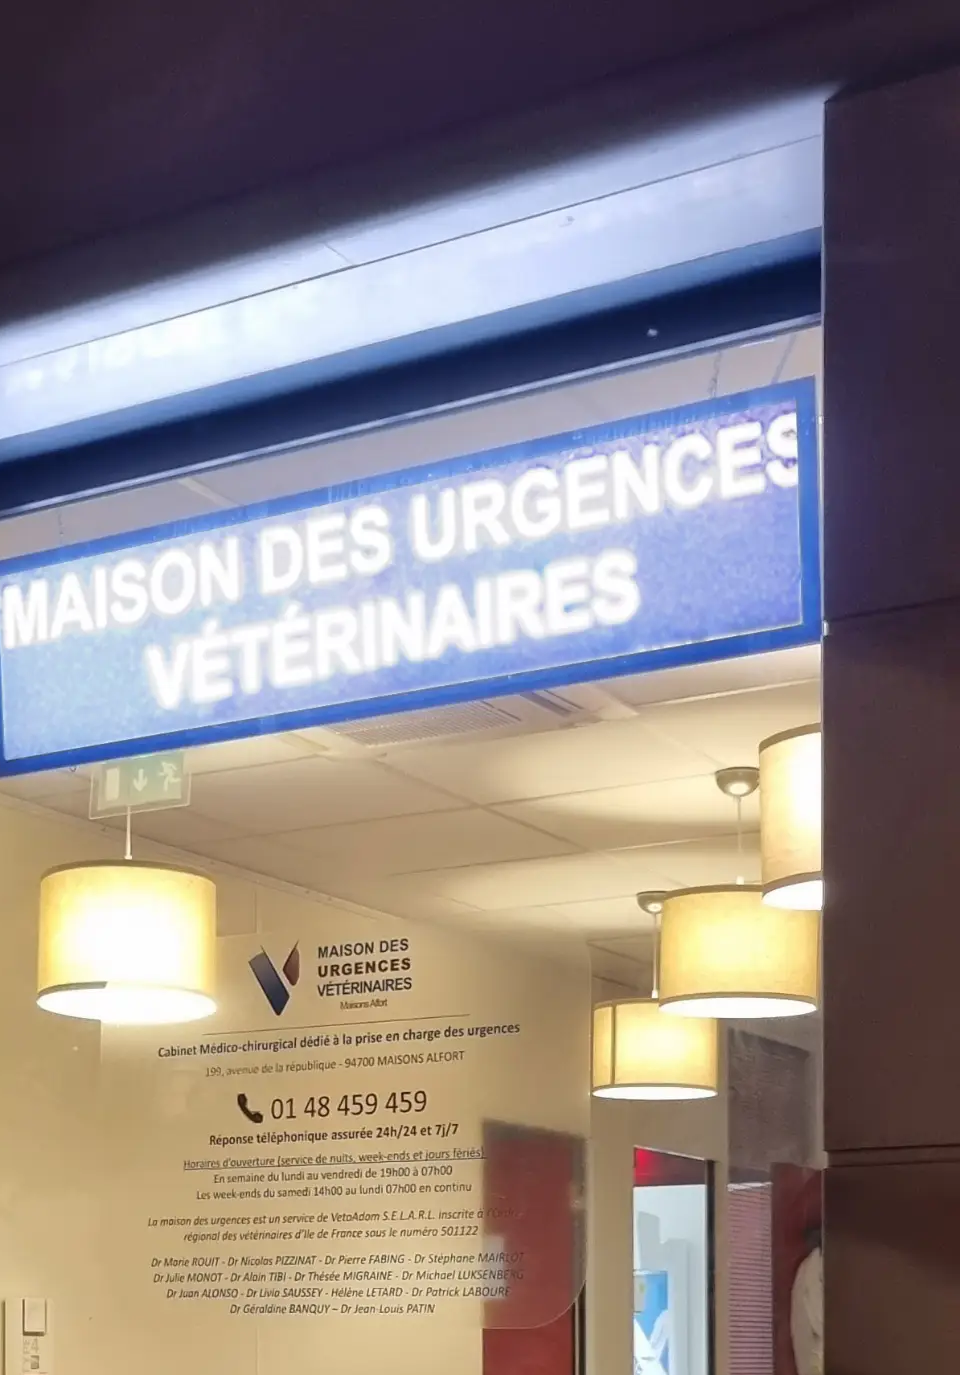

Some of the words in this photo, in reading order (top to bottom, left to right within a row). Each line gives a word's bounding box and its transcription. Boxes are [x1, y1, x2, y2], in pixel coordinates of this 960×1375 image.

[0, 543, 239, 650] MAISON
[259, 505, 392, 597] DES
[410, 409, 799, 558] URGENCES
[143, 548, 640, 710] VÉTÉRINAIRES
[317, 941, 375, 959] MAISON
[379, 938, 409, 953] DES
[317, 957, 412, 978] URGENCES
[317, 977, 412, 997] VÉTÉRINAIRES
[340, 1000, 368, 1010] Maisons
[158, 1045, 197, 1058] Cabinet
[200, 1038, 297, 1055] Médico-chirurgical
[300, 1035, 330, 1048] dédié
[333, 1035, 340, 1046] à
[342, 1033, 352, 1045] la
[355, 1031, 382, 1047] prise
[385, 1031, 400, 1042] en
[403, 1028, 441, 1044] charge
[444, 1026, 464, 1038] des
[467, 1023, 520, 1037] urgences
[205, 1066, 224, 1077] 199,
[226, 1066, 259, 1076] avenue
[261, 1063, 273, 1074] de
[275, 1062, 283, 1073] la
[286, 1058, 337, 1073] république
[344, 1056, 375, 1068] 94700
[377, 1053, 424, 1066] MAISONS
[427, 1050, 465, 1063] ALFORT
[271, 1097, 296, 1120] 01
[304, 1095, 330, 1118] 48
[337, 1093, 378, 1116] 459
[385, 1090, 427, 1113] 459
[209, 1135, 254, 1148] Réponse
[256, 1131, 328, 1145] téléphonique
[331, 1127, 373, 1141] assurée
[375, 1124, 417, 1140] 24h/24
[420, 1126, 432, 1137] et
[435, 1122, 459, 1138] 7j/7
[183, 1158, 220, 1169] Horaires
[222, 1157, 275, 1167] d'ouverture
[277, 1155, 313, 1167] (service
[315, 1153, 327, 1164] de
[330, 1153, 355, 1164] nuits,
[359, 1150, 411, 1161] week-ends
[413, 1150, 423, 1160] et
[425, 1149, 450, 1161] jours
[453, 1146, 485, 1159] fériés)
[214, 1174, 225, 1184] En
[227, 1172, 265, 1183] semaine
[268, 1171, 279, 1182] du
[282, 1170, 305, 1181] lundi
[306, 1172, 319, 1181] au
[321, 1168, 362, 1180] vendredi
[365, 1168, 377, 1179] de
[380, 1166, 411, 1178] 19h00
[412, 1167, 420, 1177] à
[421, 1165, 453, 1176] 07h00
[196, 1190, 211, 1201] Les
[213, 1188, 261, 1200] week-ends
[263, 1187, 275, 1198] du
[277, 1186, 311, 1198] samedi
[314, 1185, 343, 1197] 14h00
[345, 1187, 357, 1196] au
[359, 1184, 383, 1195] lundi
[386, 1183, 416, 1194] 07h00
[419, 1185, 431, 1194] en
[434, 1182, 472, 1193] continu
[147, 1217, 158, 1227] La
[160, 1217, 191, 1227] maison
[193, 1216, 208, 1226] des
[211, 1216, 251, 1227] urgences
[253, 1215, 267, 1225] est
[268, 1215, 280, 1224] un
[282, 1213, 315, 1224] service
[317, 1213, 329, 1223] de
[477, 1207, 485, 1218] à
[184, 1231, 220, 1244] régional
[222, 1230, 237, 1241] des
[239, 1229, 293, 1241] vétérinaires
[317, 1229, 329, 1239] de
[331, 1227, 363, 1239] France
[365, 1228, 386, 1238] sous
[388, 1227, 398, 1237] le
[400, 1226, 438, 1237] numéro
[441, 1225, 478, 1236] 501122
[151, 1257, 162, 1267] Dr
[163, 1258, 189, 1267] Marie
[191, 1257, 220, 1267] ROUIT
[227, 1257, 239, 1267] Dr
[241, 1256, 273, 1266] Nicolas
[275, 1255, 317, 1266] PIZZINAT
[325, 1255, 336, 1265] Dr
[338, 1254, 366, 1265] Pierre
[368, 1254, 405, 1265] FABING
[414, 1254, 426, 1264] Dr
[428, 1252, 475, 1265] Stéphane
[153, 1273, 164, 1283] Dr
[165, 1273, 185, 1283] Julie
[187, 1272, 223, 1283] MONOT
[230, 1272, 241, 1282] Dr
[243, 1272, 266, 1282] Alain
[268, 1272, 286, 1282] TIBI
[294, 1271, 305, 1281] Dr
[308, 1270, 340, 1281] Thésée
[343, 1271, 392, 1282] MIGRAINE
[402, 1271, 413, 1281] Dr
[167, 1288, 177, 1298] Dr
[179, 1288, 199, 1299] Juan
[201, 1288, 239, 1299] ALONSO
[246, 1288, 257, 1298] Dr
[259, 1287, 280, 1298] Livia
[281, 1287, 323, 1298] SAUSSEY
[331, 1287, 363, 1297] Hélène
[366, 1286, 403, 1297] LETARD
[412, 1287, 423, 1297] Dr
[425, 1286, 459, 1297] Patrick
[230, 1304, 240, 1314] Dr
[243, 1303, 287, 1314] Géraldine
[289, 1304, 330, 1315] BANQUY
[340, 1303, 352, 1313] Dr
[406, 1303, 435, 1314] PATIN
